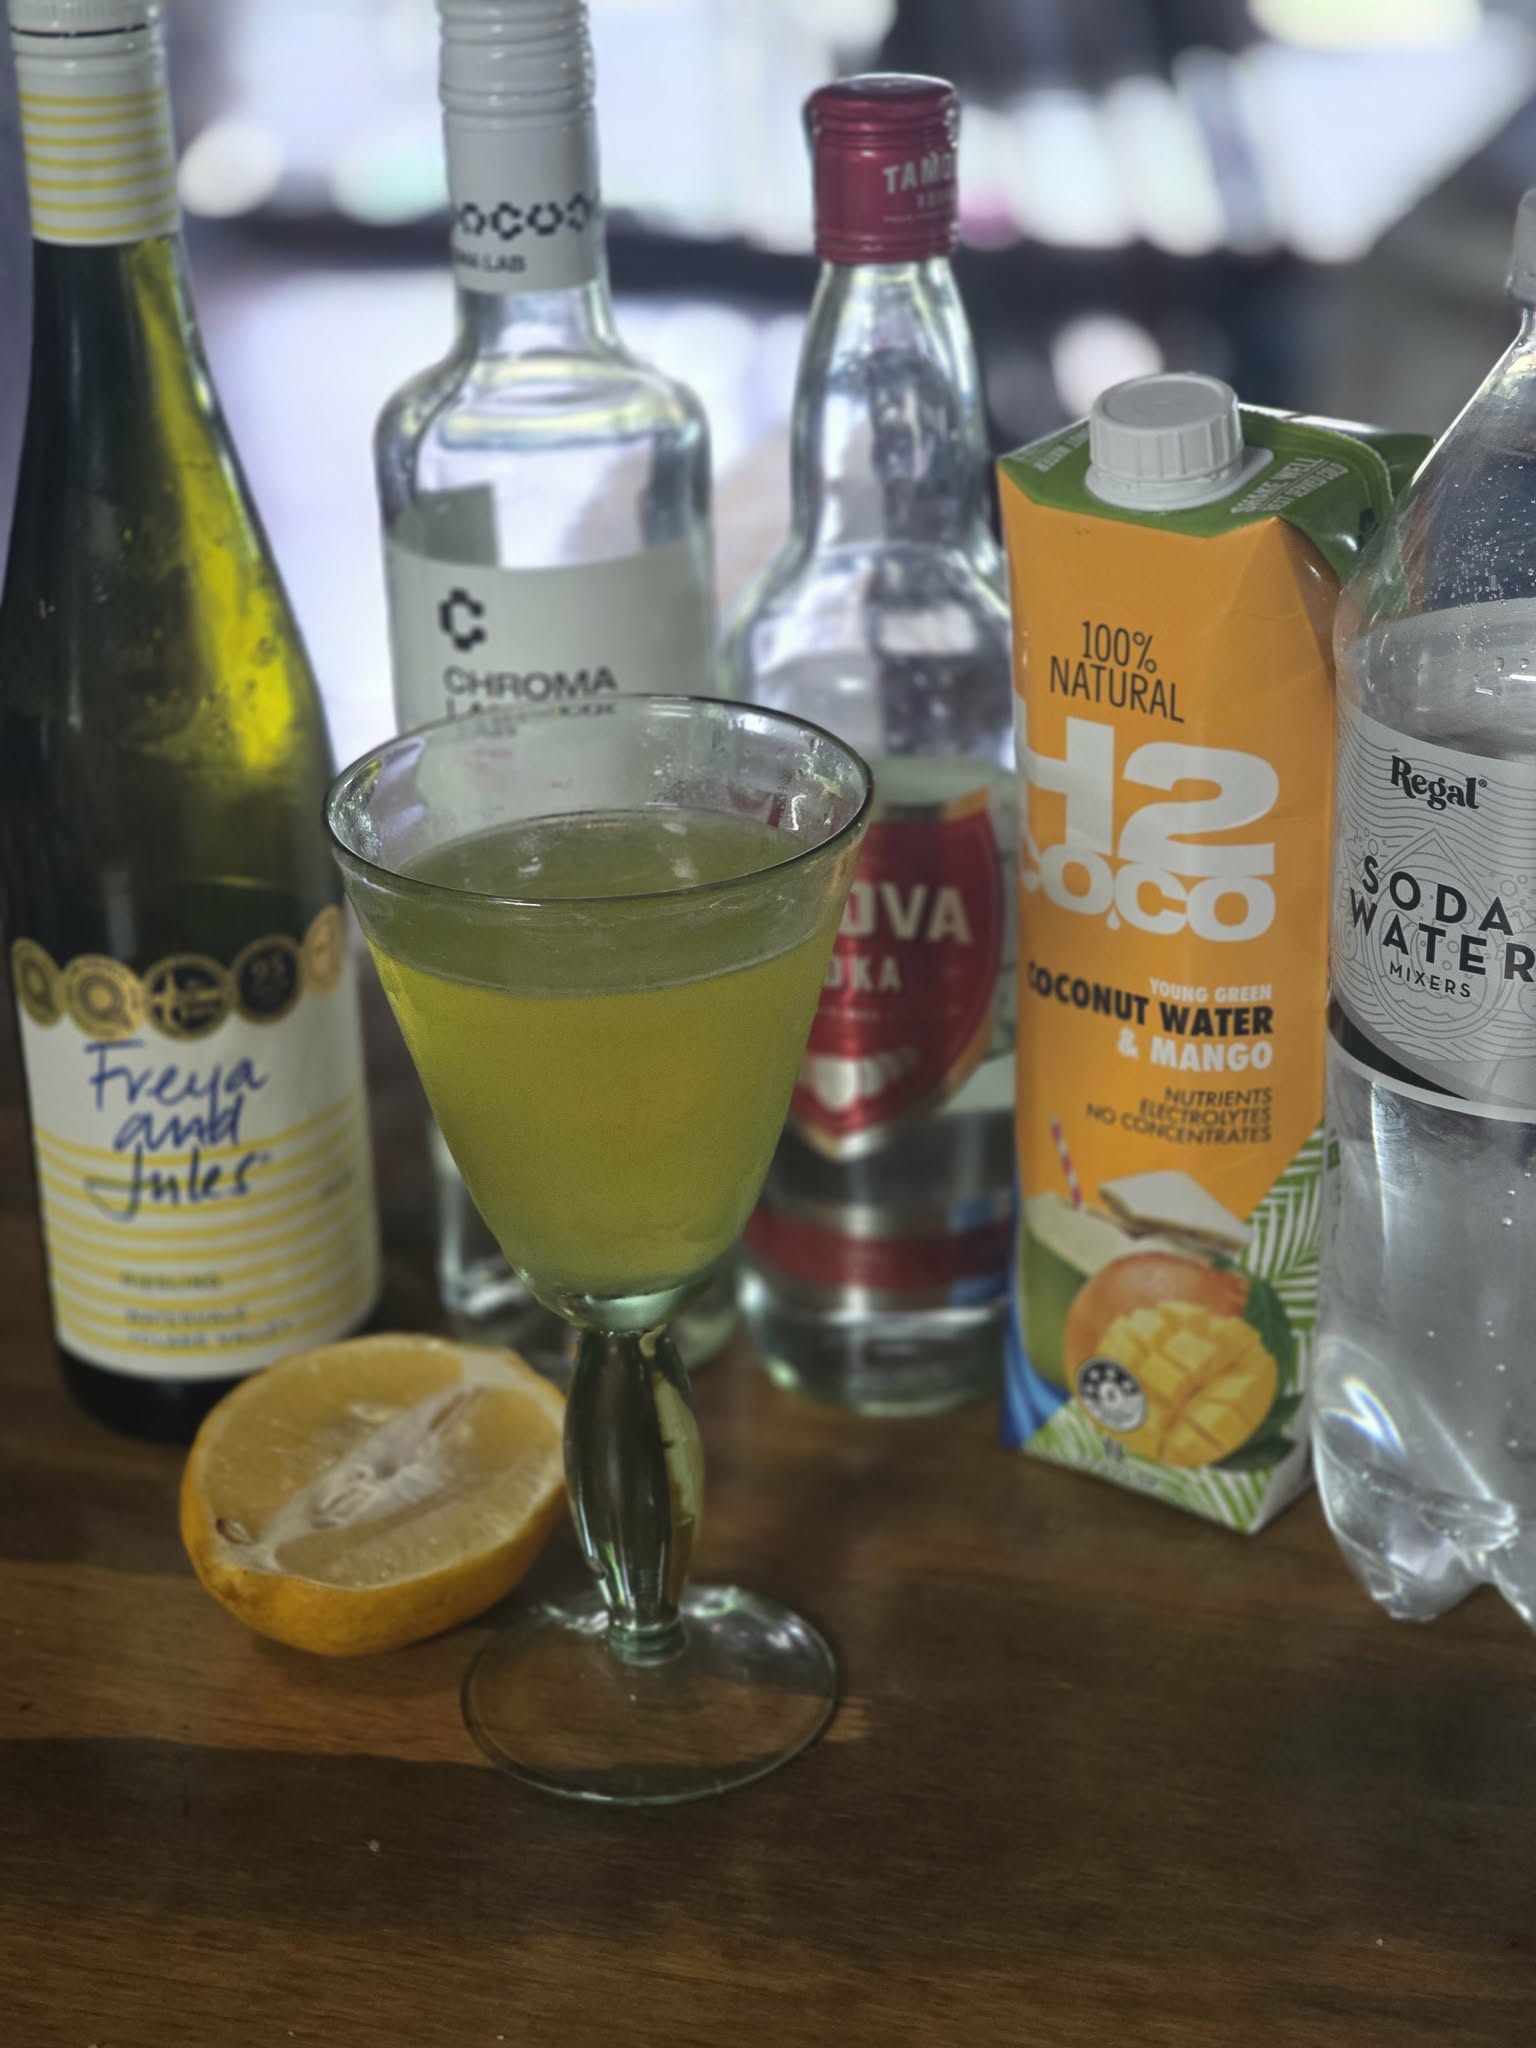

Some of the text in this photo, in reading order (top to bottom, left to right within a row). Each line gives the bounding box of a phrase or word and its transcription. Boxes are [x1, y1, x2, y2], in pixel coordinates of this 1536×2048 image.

[1081, 619, 1158, 674] 100%
[443, 665, 619, 702] CHROMA
[1049, 655, 1185, 724] NATURAL
[1361, 854, 1514, 937] SODA
[1350, 887, 1536, 984] WATER
[1150, 976, 1272, 1004] YOUNG GREEN
[1389, 959, 1472, 999] MIXERS
[1159, 1001, 1274, 1037] WATER
[1117, 1027, 1274, 1073] & MANGO
[84, 1039, 270, 1138] Freya
[1165, 1085, 1273, 1107] NUTRIENTS
[113, 1092, 245, 1152] and
[1086, 1102, 1273, 1145] NO CONCENTRATES
[1139, 1097, 1273, 1127] ELECTROLYTES
[84, 1141, 260, 1225] Jules
